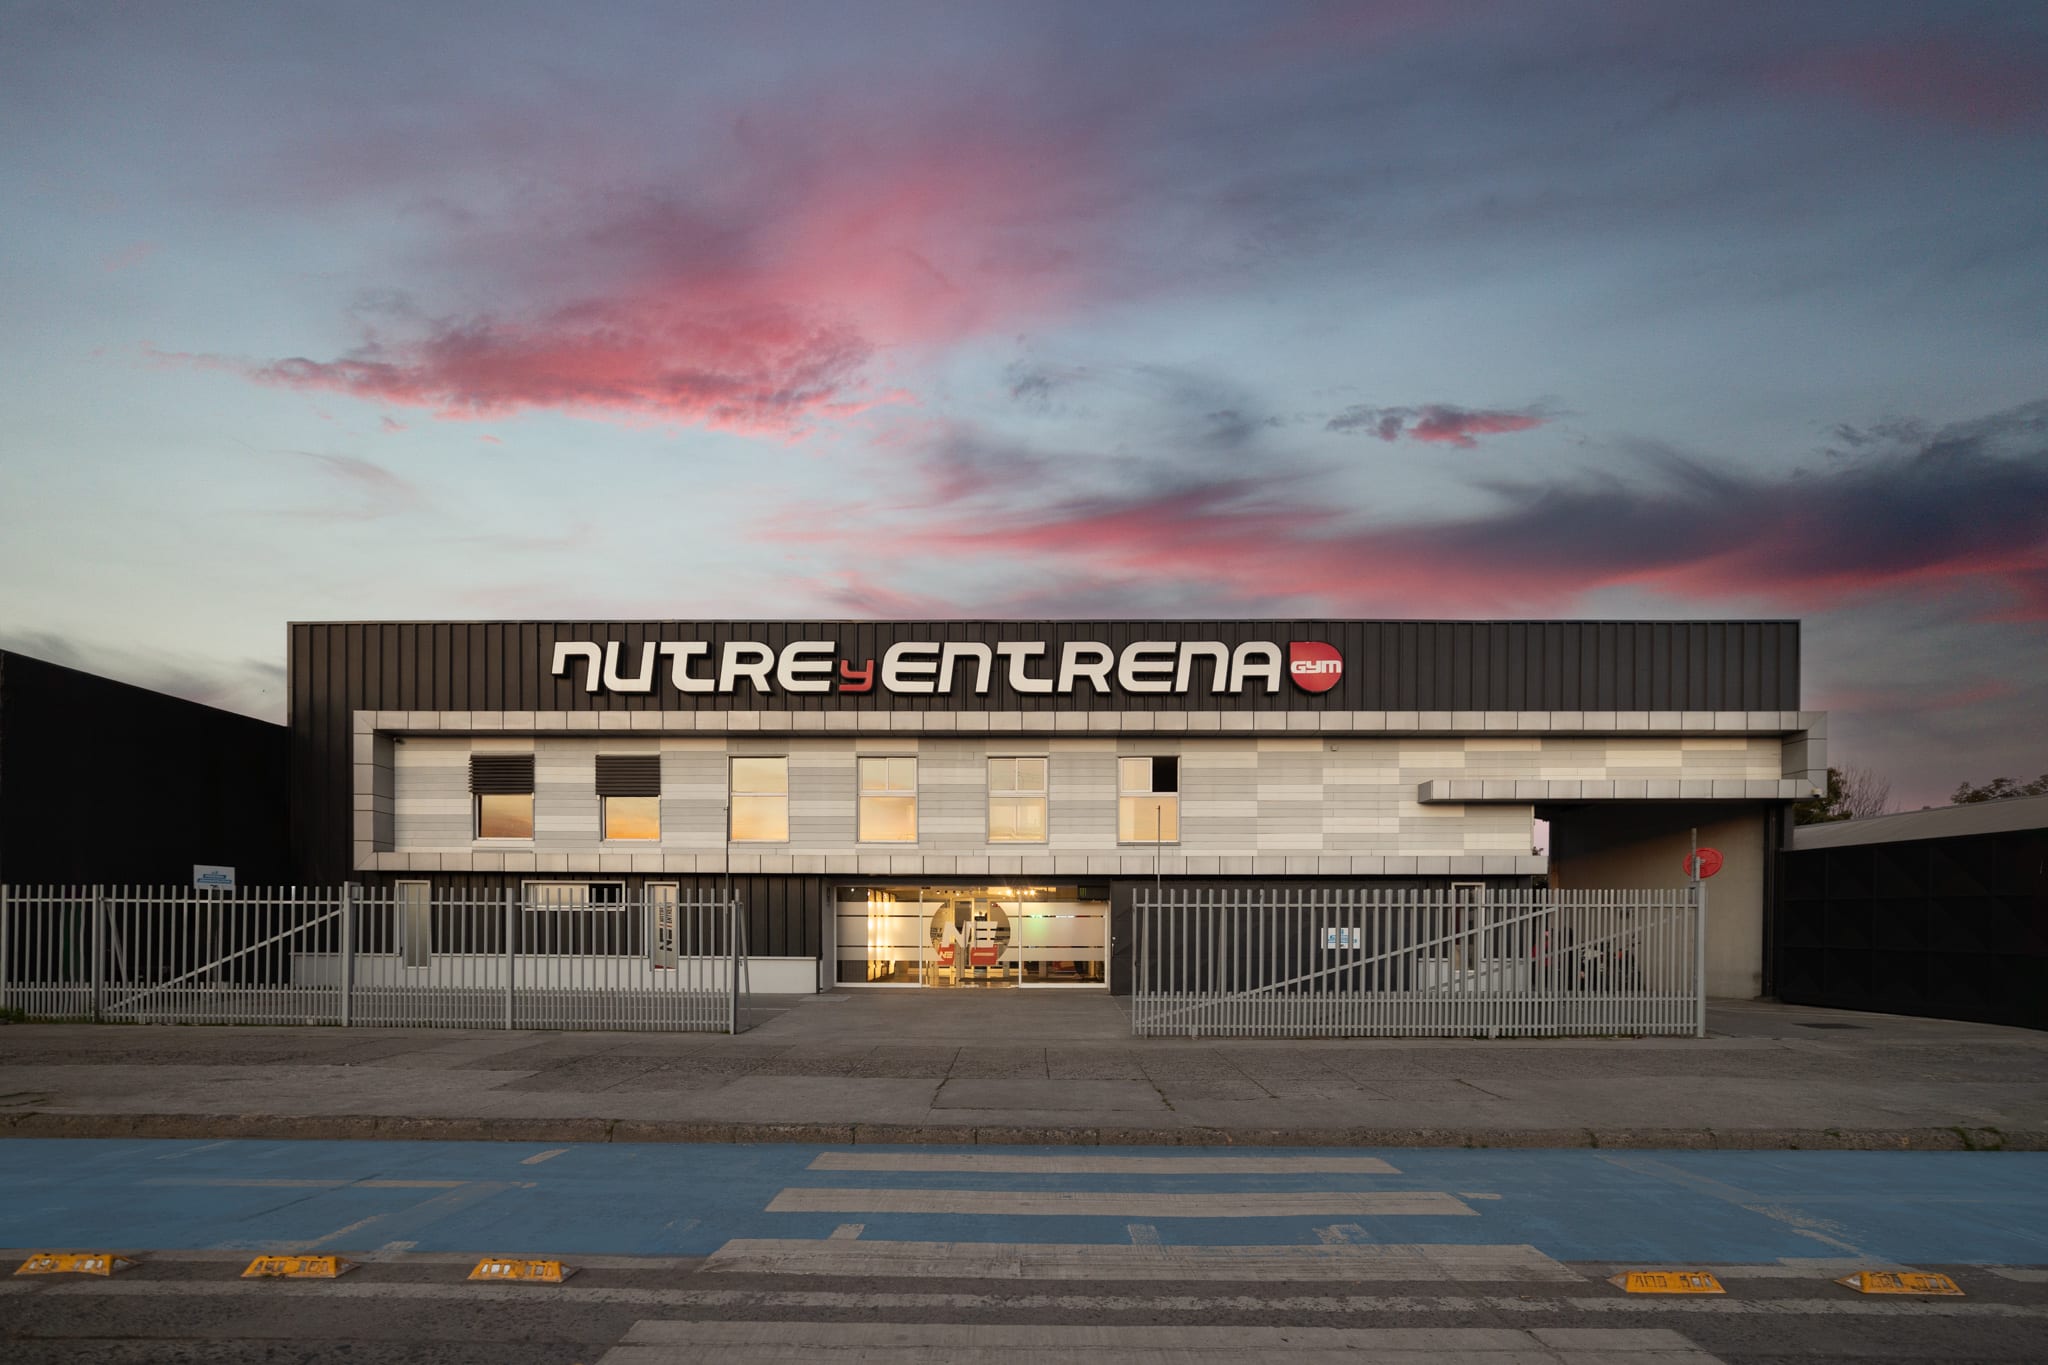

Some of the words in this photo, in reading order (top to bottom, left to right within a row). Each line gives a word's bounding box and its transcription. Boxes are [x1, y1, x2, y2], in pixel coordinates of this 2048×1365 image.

[552, 641, 836, 692] NUTRE
[881, 641, 1282, 693] ENTRENA
[1290, 660, 1342, 674] GYM
[941, 921, 998, 948] NE
